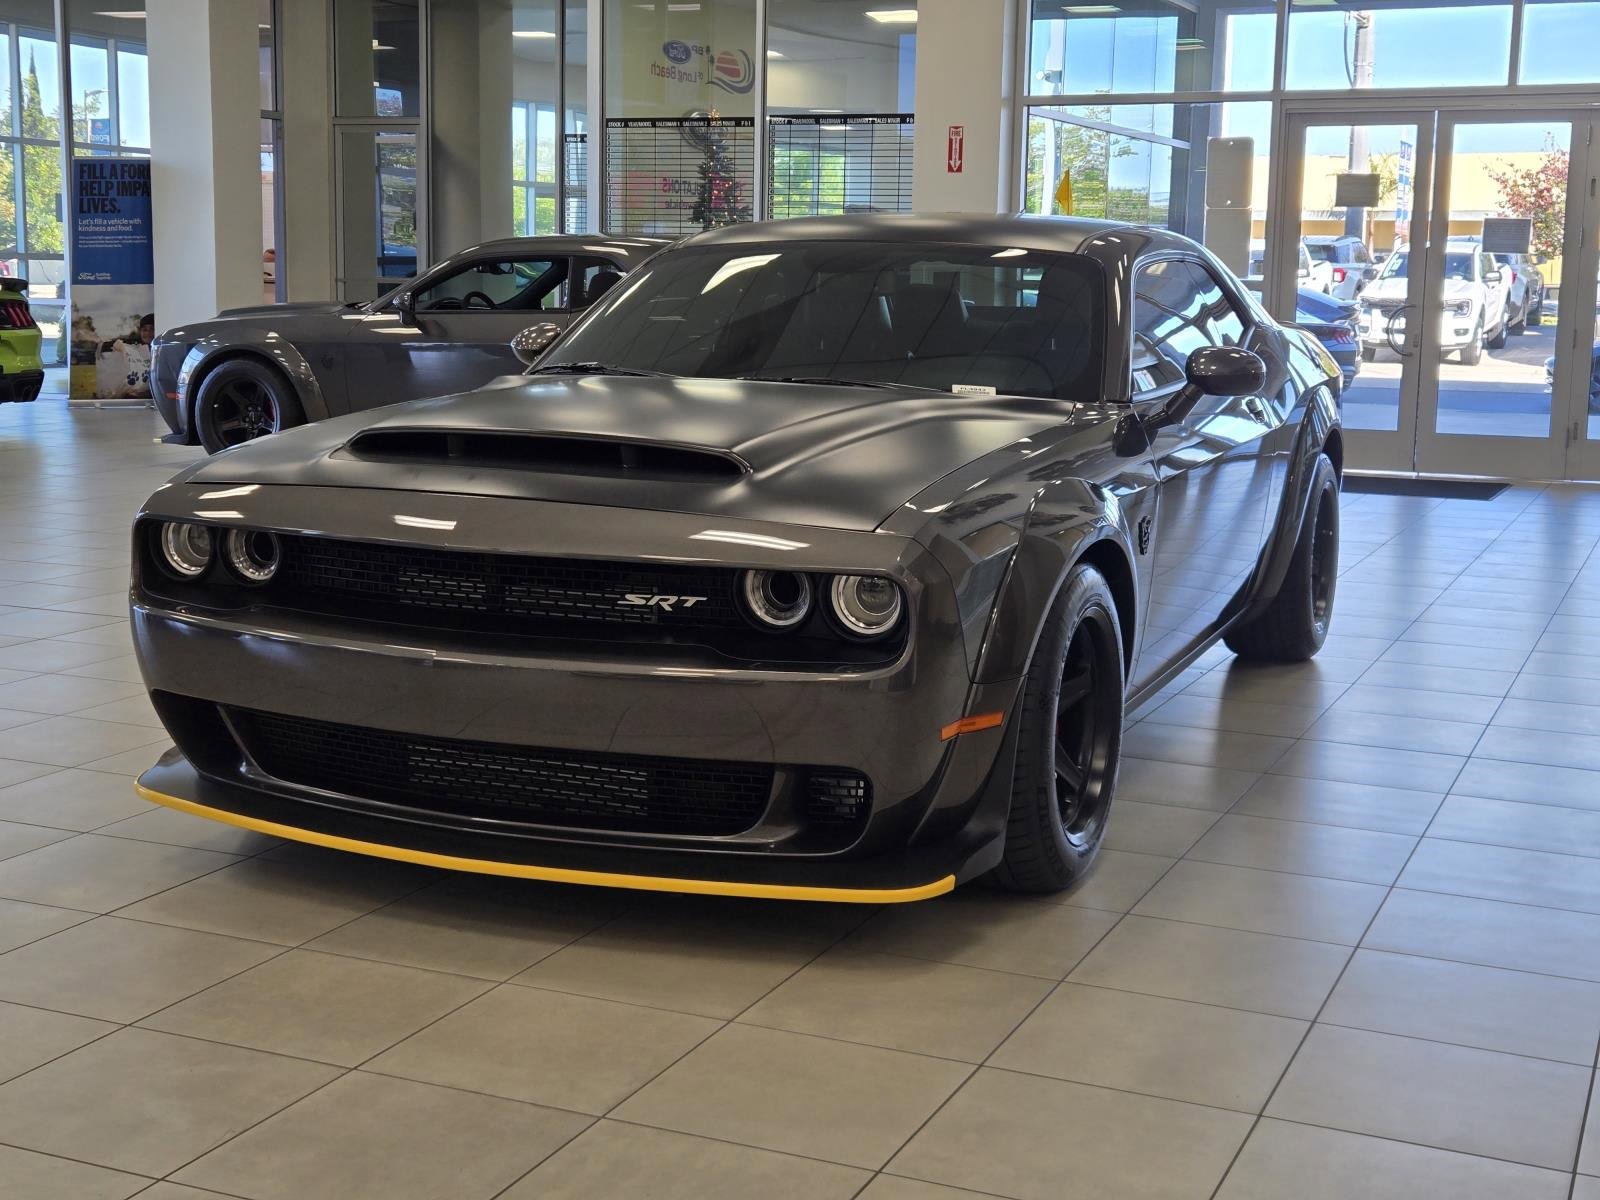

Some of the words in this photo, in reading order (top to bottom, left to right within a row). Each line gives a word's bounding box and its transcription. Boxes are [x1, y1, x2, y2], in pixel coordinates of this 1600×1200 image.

[80, 164, 107, 179] FILL
[110, 164, 118, 179] A
[79, 180, 114, 196] HELP
[117, 180, 151, 196] IMPA
[79, 197, 121, 213] LIVES.
[617, 593, 708, 611] SRT
